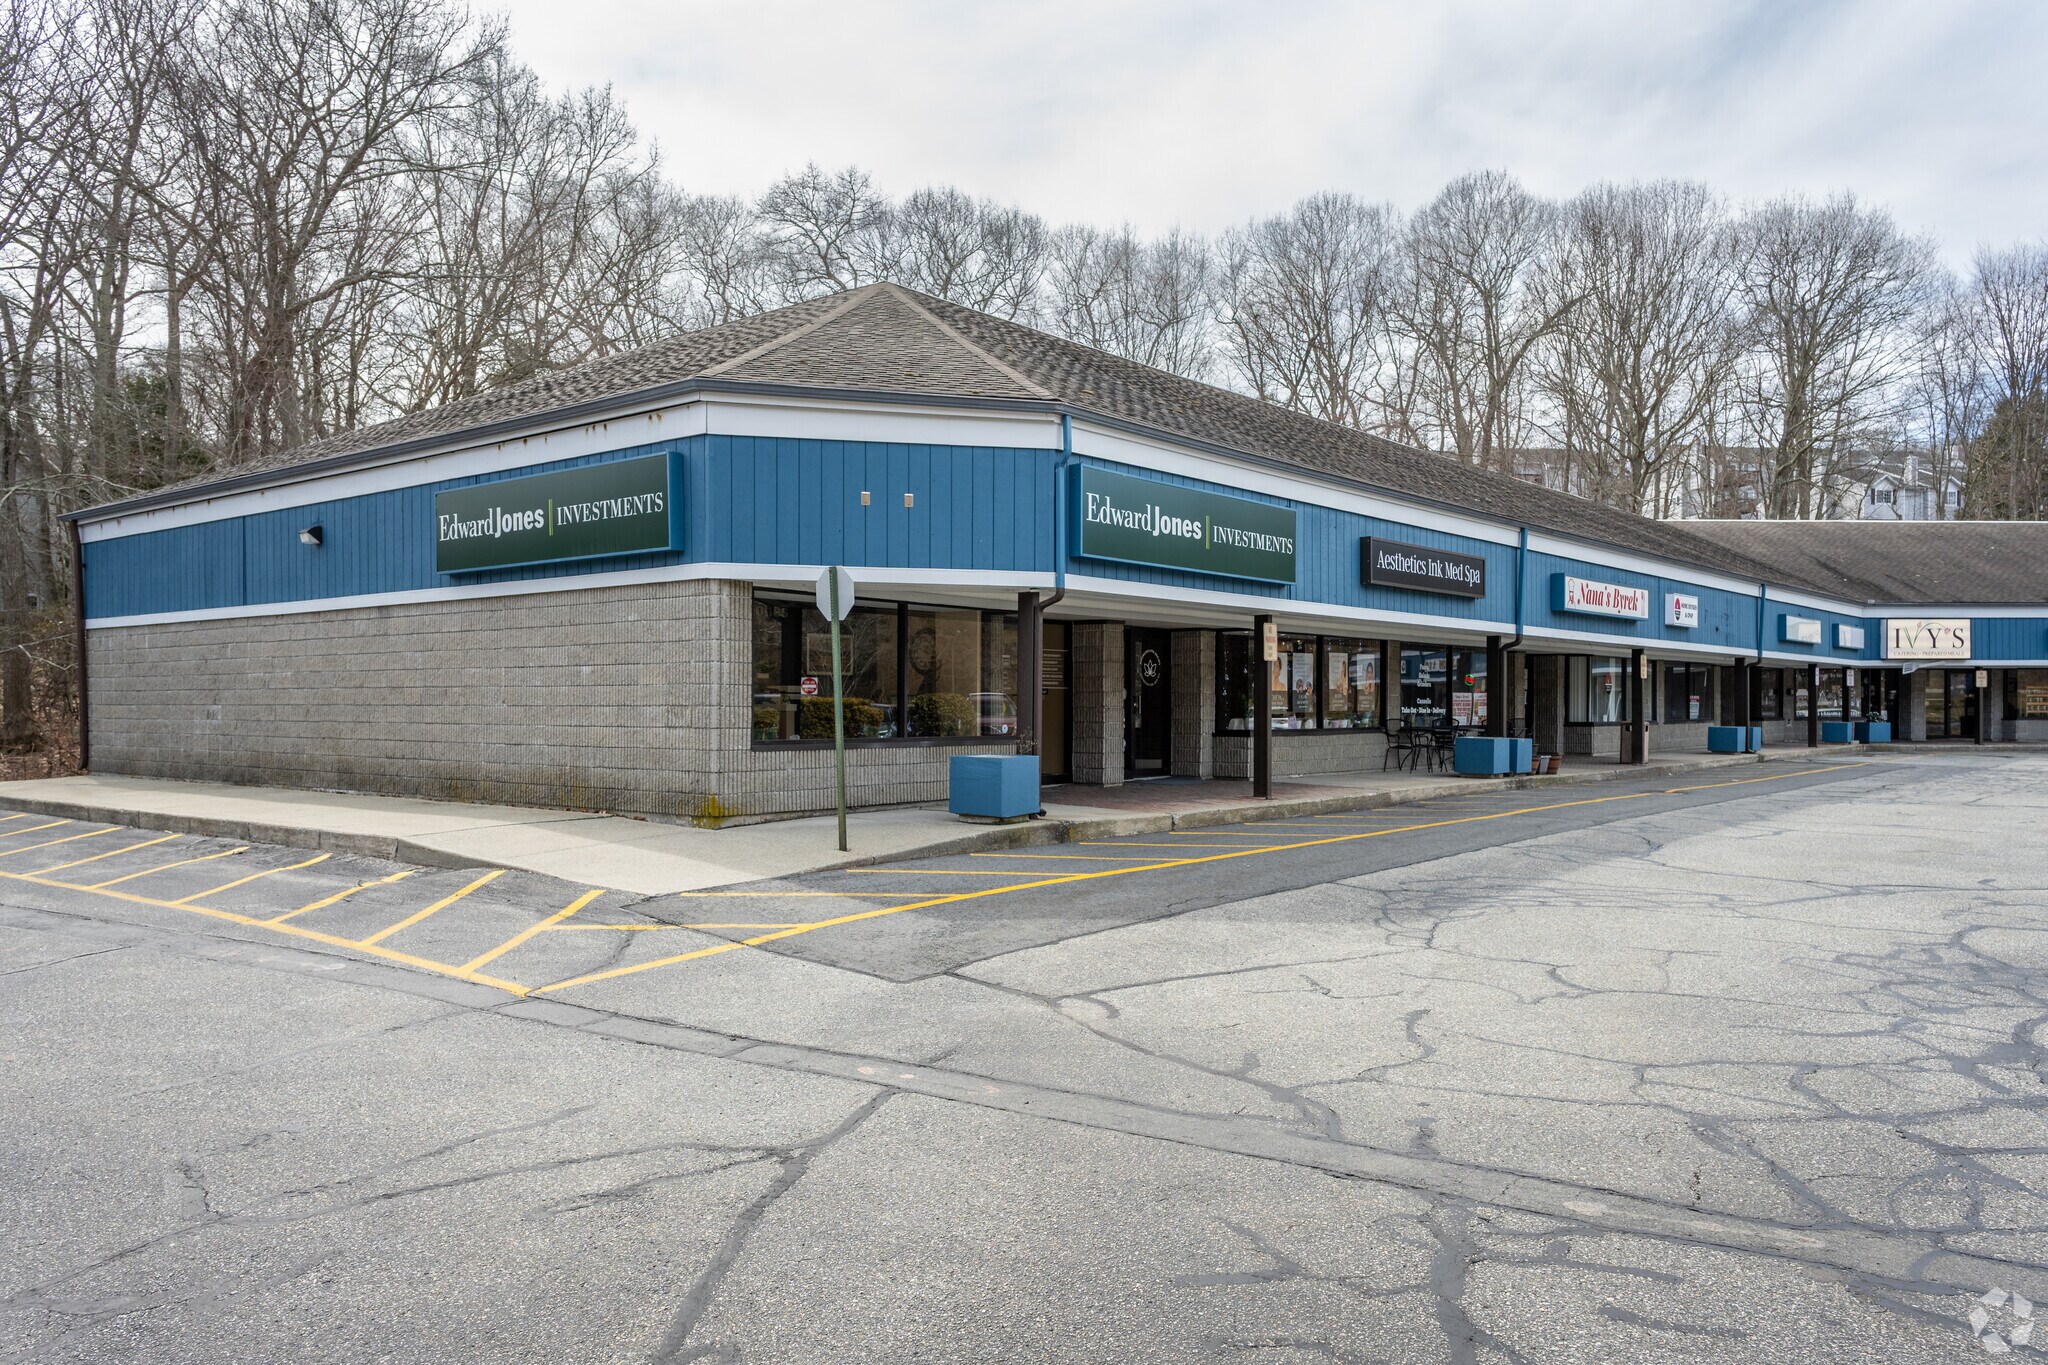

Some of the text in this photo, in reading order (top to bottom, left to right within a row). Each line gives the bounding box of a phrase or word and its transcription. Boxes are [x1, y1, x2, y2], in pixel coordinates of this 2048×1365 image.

[557, 492, 664, 526] INVESTMENTS
[1213, 525, 1293, 555] INVESTMENTS
[1376, 550, 1481, 587] Aesthetics Ink Med Spa
[1577, 582, 1639, 613] Nana's Byrek
